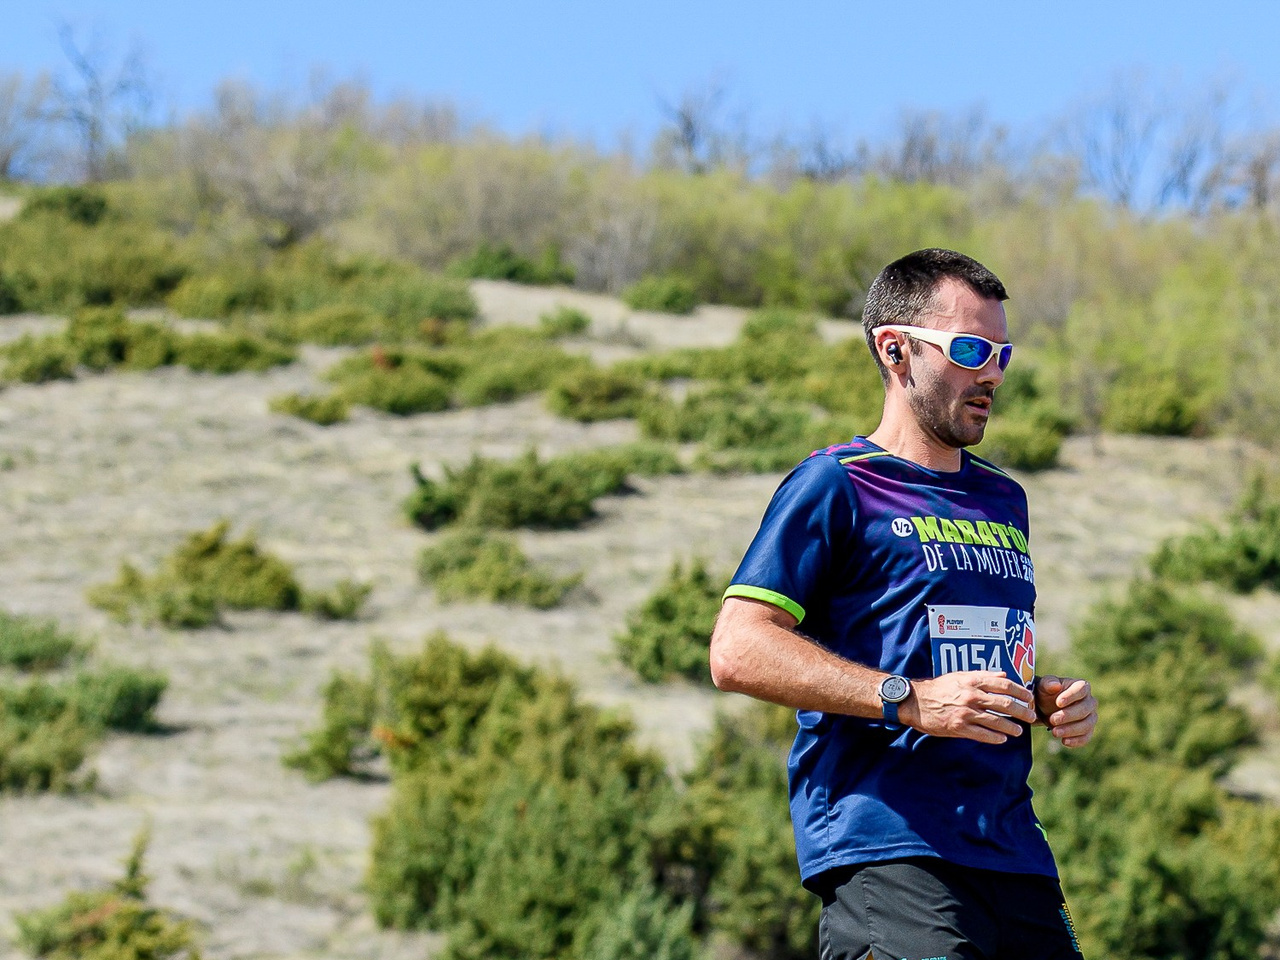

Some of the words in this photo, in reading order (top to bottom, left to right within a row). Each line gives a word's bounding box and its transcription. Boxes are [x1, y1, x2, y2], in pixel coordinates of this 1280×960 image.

[921, 543, 949, 572] DE
[949, 543, 974, 571] LA
[971, 545, 1024, 579] MUJER
[939, 642, 1003, 676] 0154
